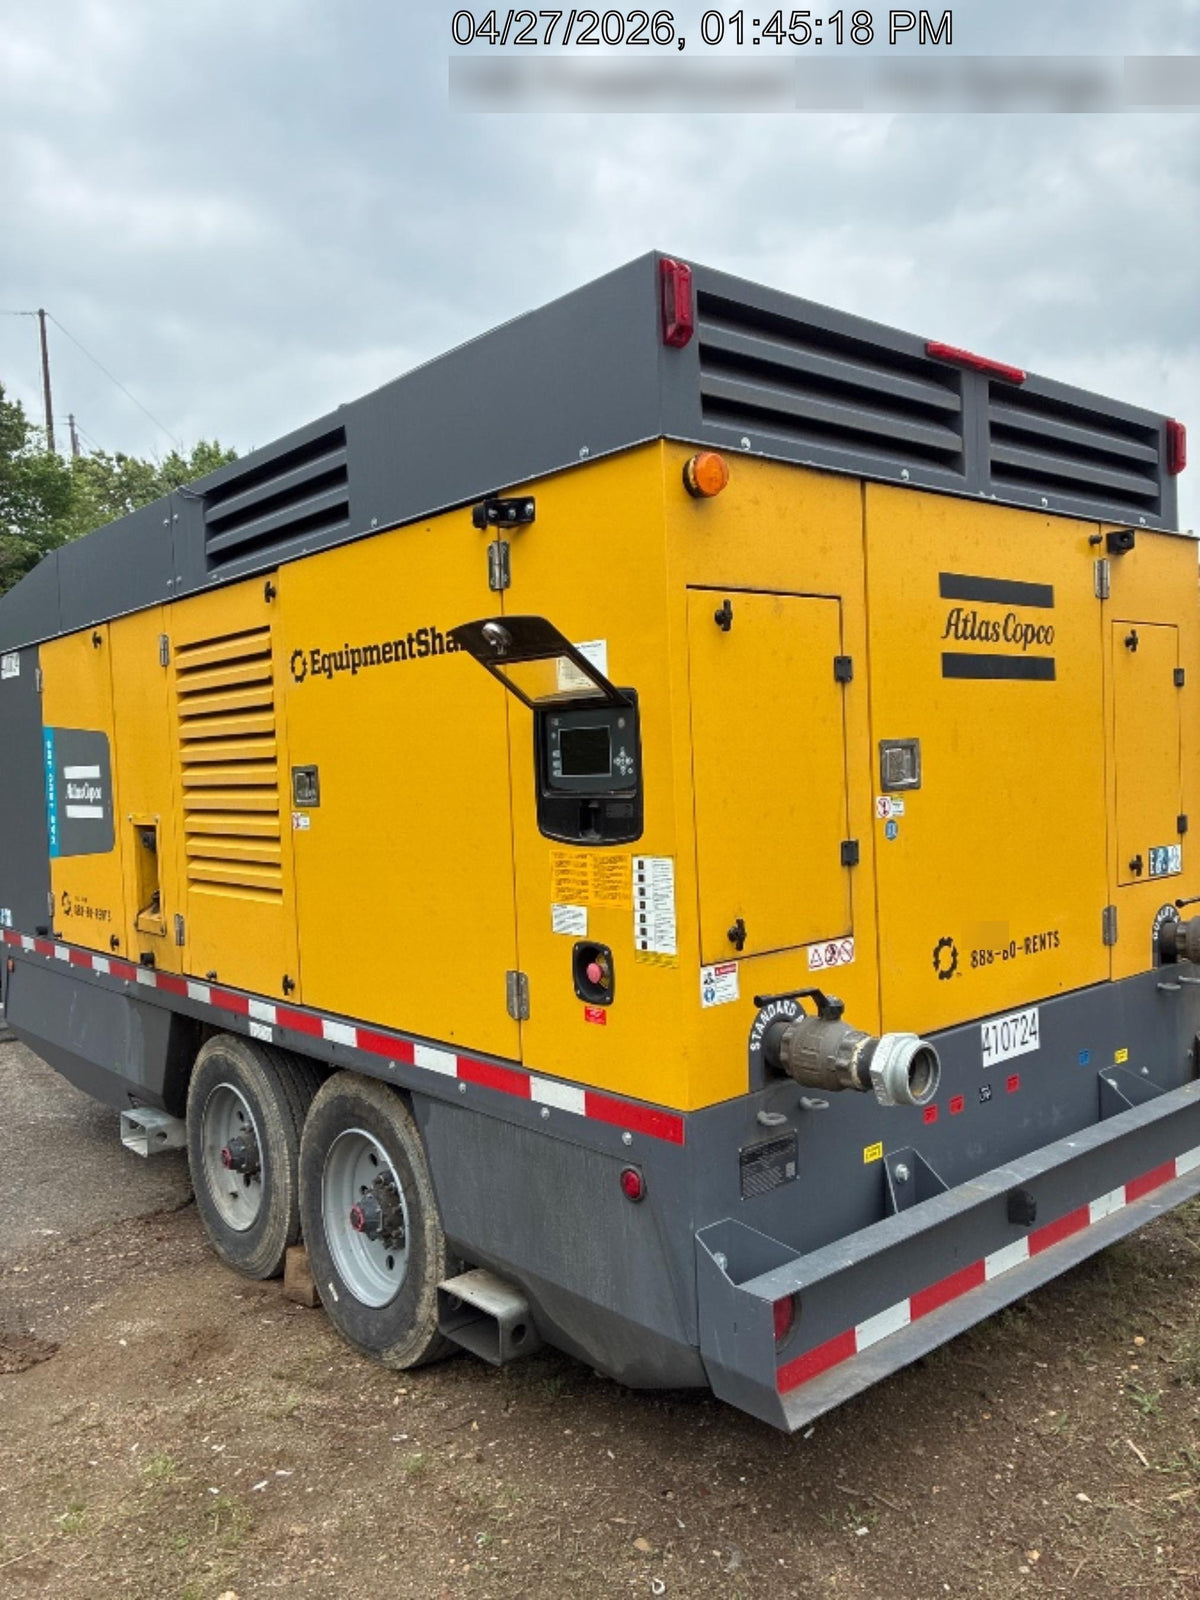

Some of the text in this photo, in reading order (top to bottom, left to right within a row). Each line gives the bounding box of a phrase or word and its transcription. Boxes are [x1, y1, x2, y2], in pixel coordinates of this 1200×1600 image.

[310, 625, 466, 680] EquipmentSha
[749, 999, 798, 1052] STANDARD
[981, 1011, 1038, 1058] 410724
